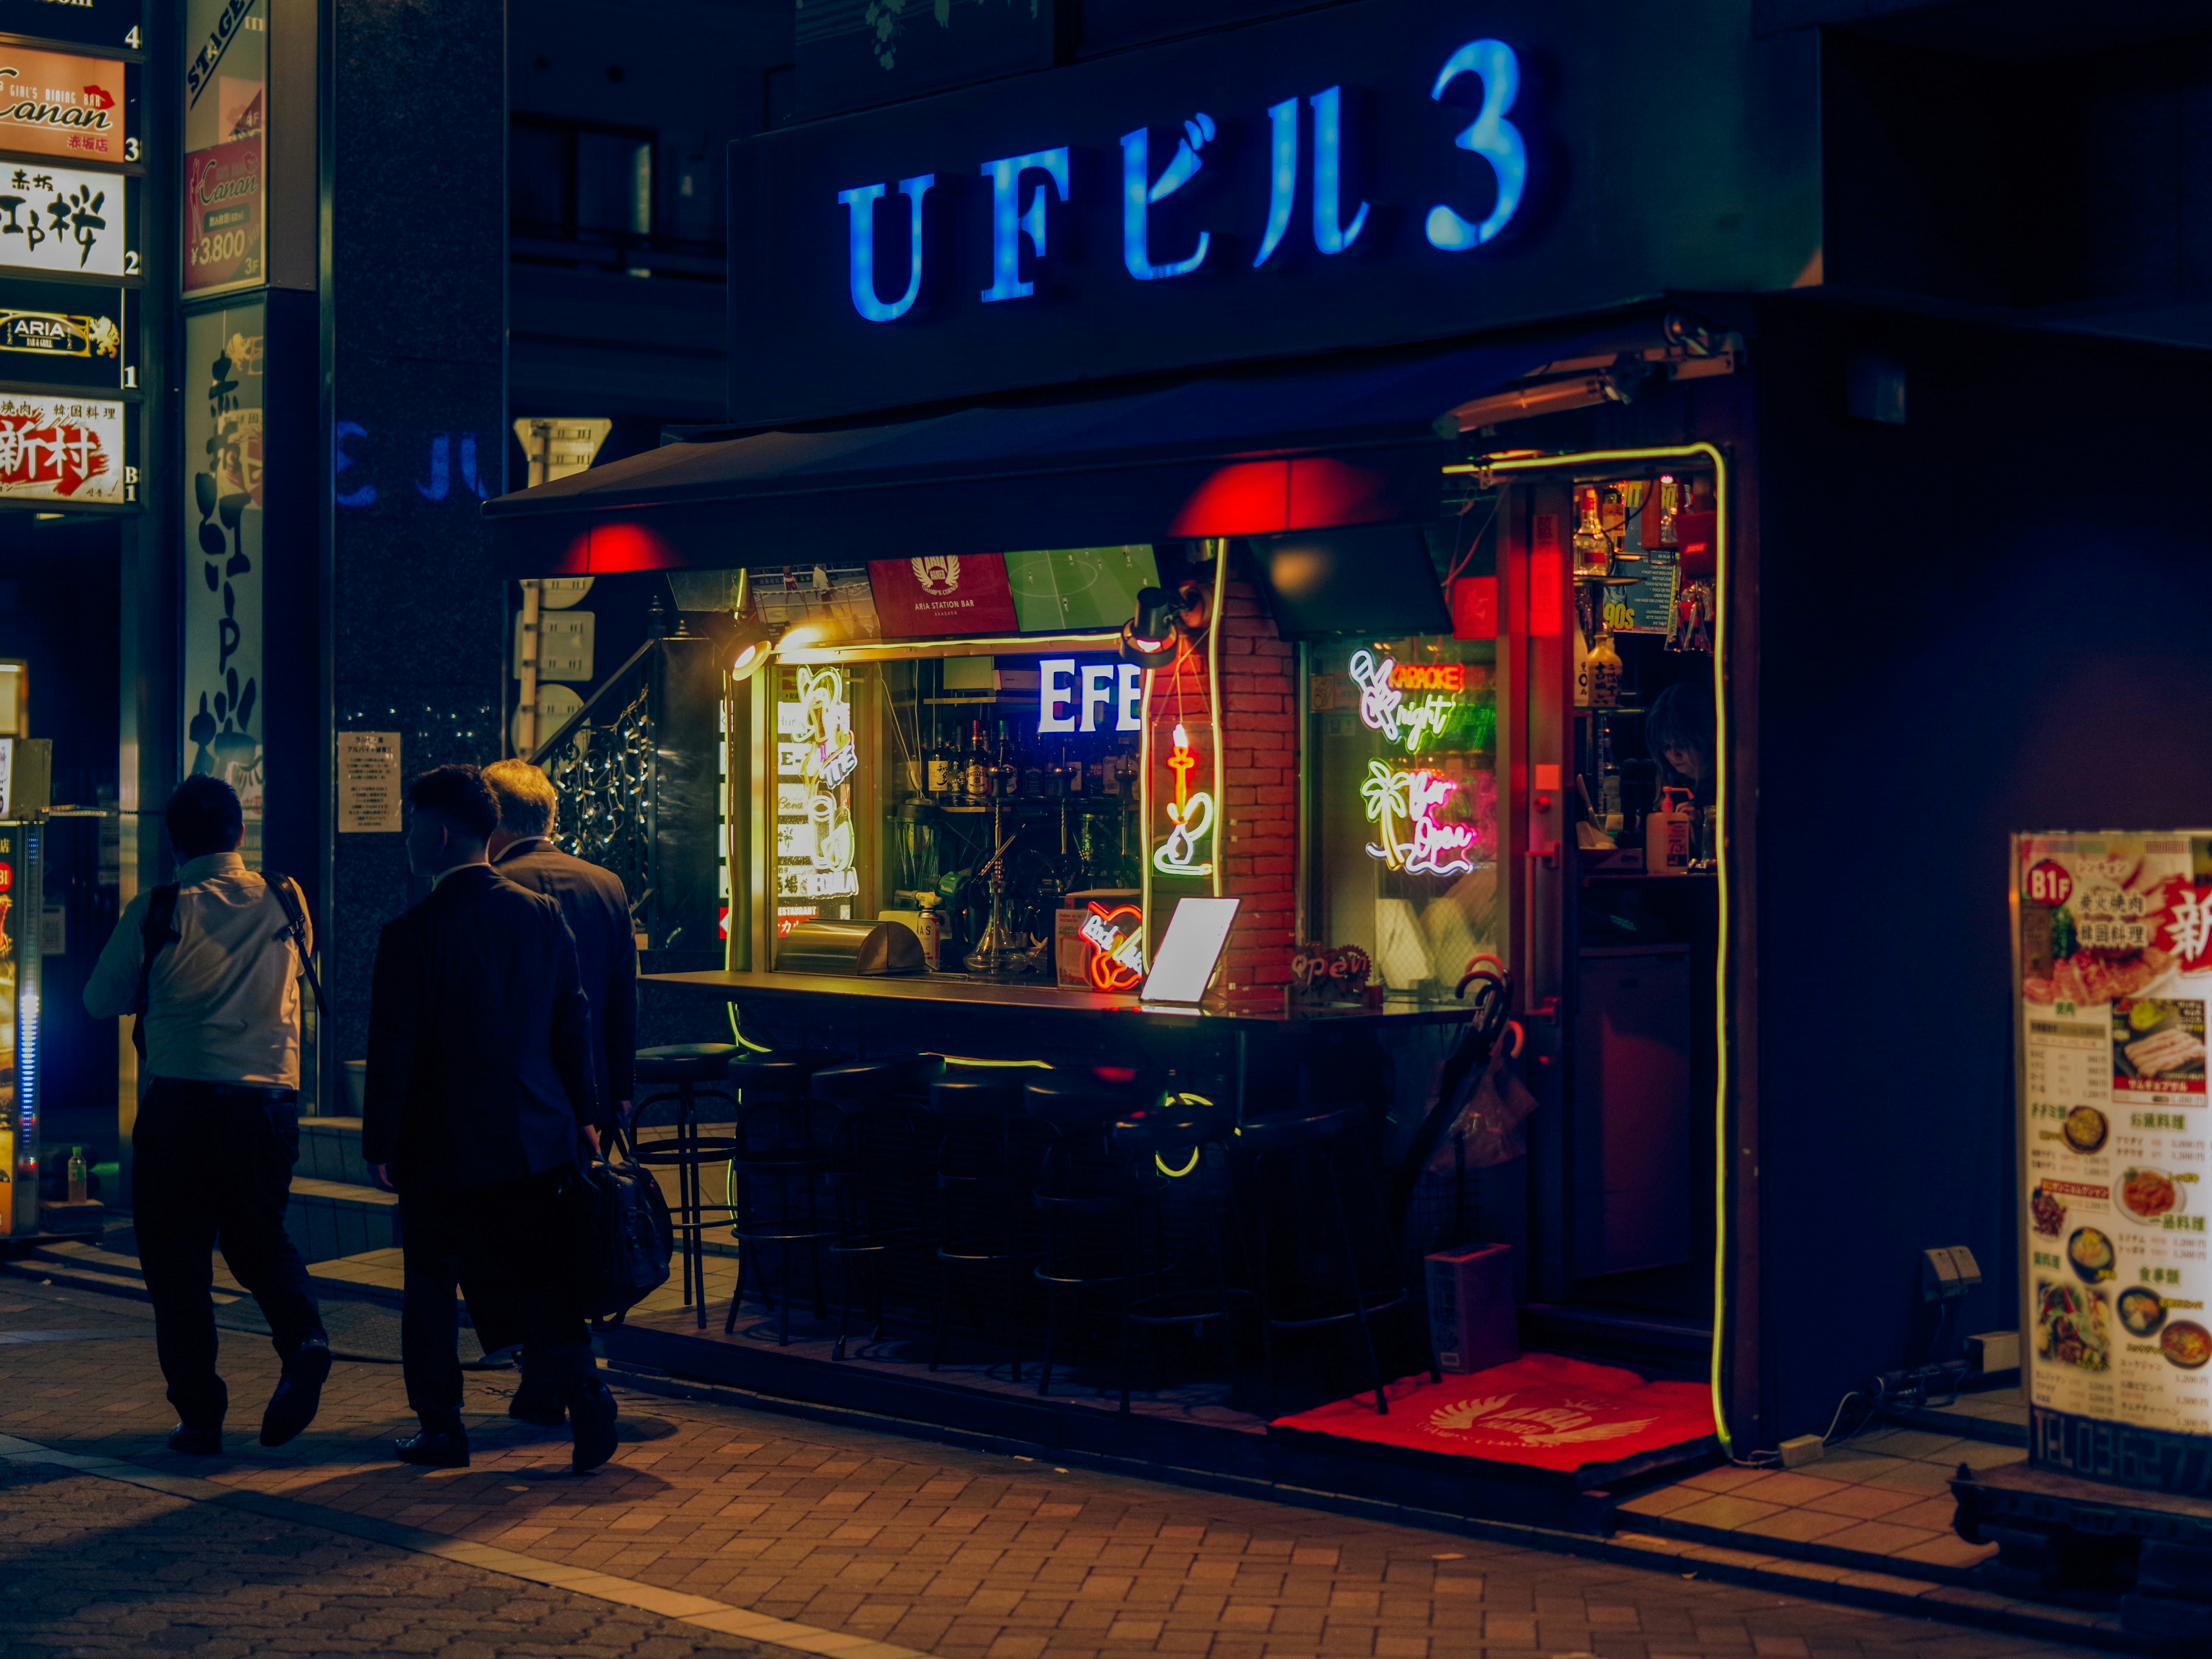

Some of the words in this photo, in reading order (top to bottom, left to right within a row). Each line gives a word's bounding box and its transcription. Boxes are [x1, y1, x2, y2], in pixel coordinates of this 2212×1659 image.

[125, 25, 141, 49] 4
[10, 84, 38, 99] GIRL'S
[46, 88, 76, 105] DINING
[84, 93, 102, 108] BAR
[67, 135, 108, 151] 赤坂店
[126, 138, 140, 161] 3
[12, 169, 54, 192] 赤坂
[200, 159, 258, 206] Canan
[191, 229, 245, 265] ¥3,800
[125, 251, 140, 275] 2
[245, 257, 258, 275] 3F
[15, 320, 66, 338] ARIA
[27, 338, 35, 347] BAR
[40, 339, 53, 349] GRILL
[125, 365, 138, 388] 1
[929, 569, 946, 580] HAMED
[922, 585, 942, 596] CHAMP'S
[942, 582, 959, 595] CORNER
[932, 600, 959, 609] STATION
[961, 599, 975, 608] BAR
[1389, 665, 1462, 691] KARAOKE
[936, 763, 948, 786] 知多
[1415, 816, 1473, 864] Open
[2078, 863, 2126, 875] シンチョン
[2032, 869, 2071, 901] B1F
[2080, 893, 2143, 912] 炭火焼肉
[2080, 924, 2144, 944] 韓国料理
